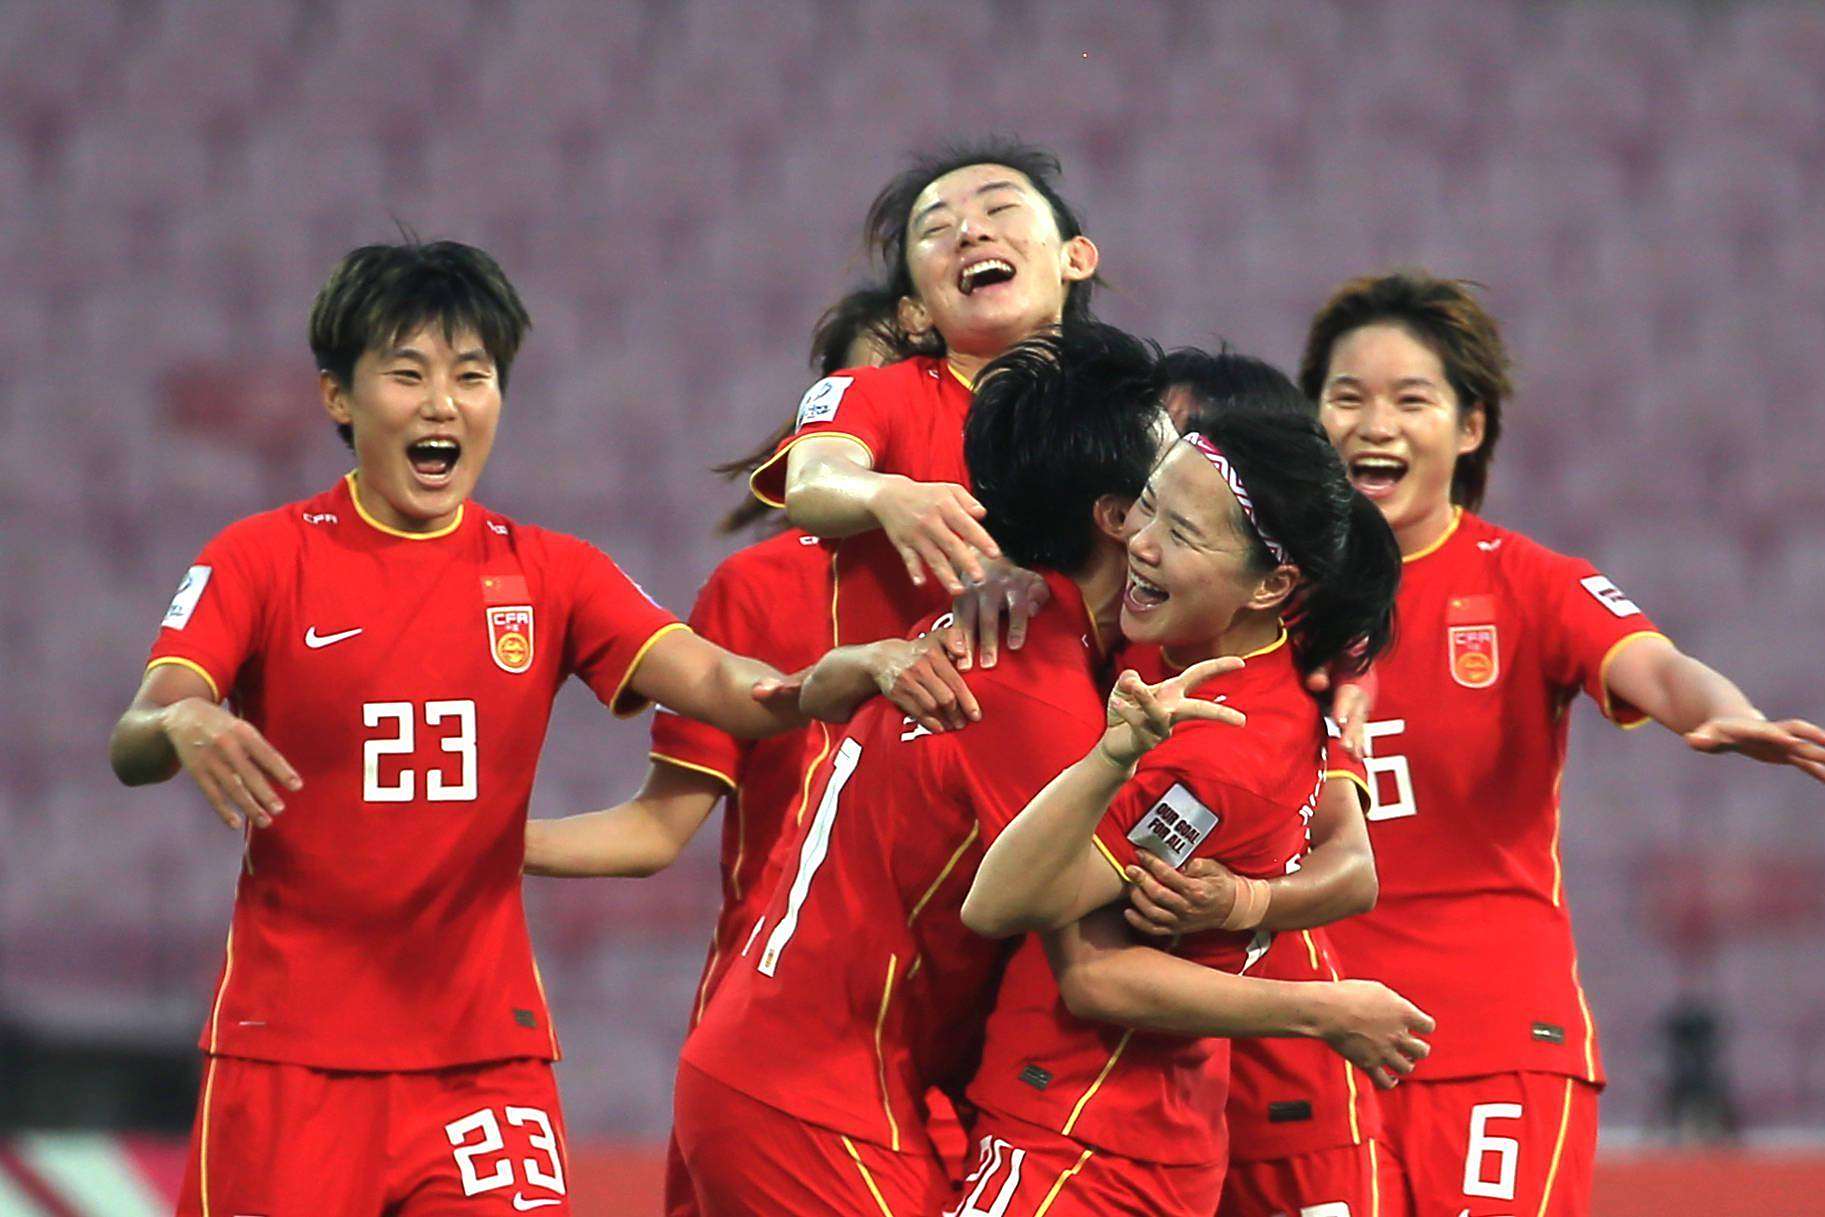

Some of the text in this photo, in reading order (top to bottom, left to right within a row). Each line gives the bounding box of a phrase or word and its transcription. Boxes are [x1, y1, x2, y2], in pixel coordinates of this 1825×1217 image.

[493, 612, 529, 625] CFA
[363, 699, 478, 802] 23
[1363, 719, 1418, 821] 6
[1147, 817, 1186, 855] FOR ALL
[1156, 802, 1201, 845] OUR GOAL
[445, 1106, 567, 1197] 23
[1463, 1103, 1523, 1200] 6
